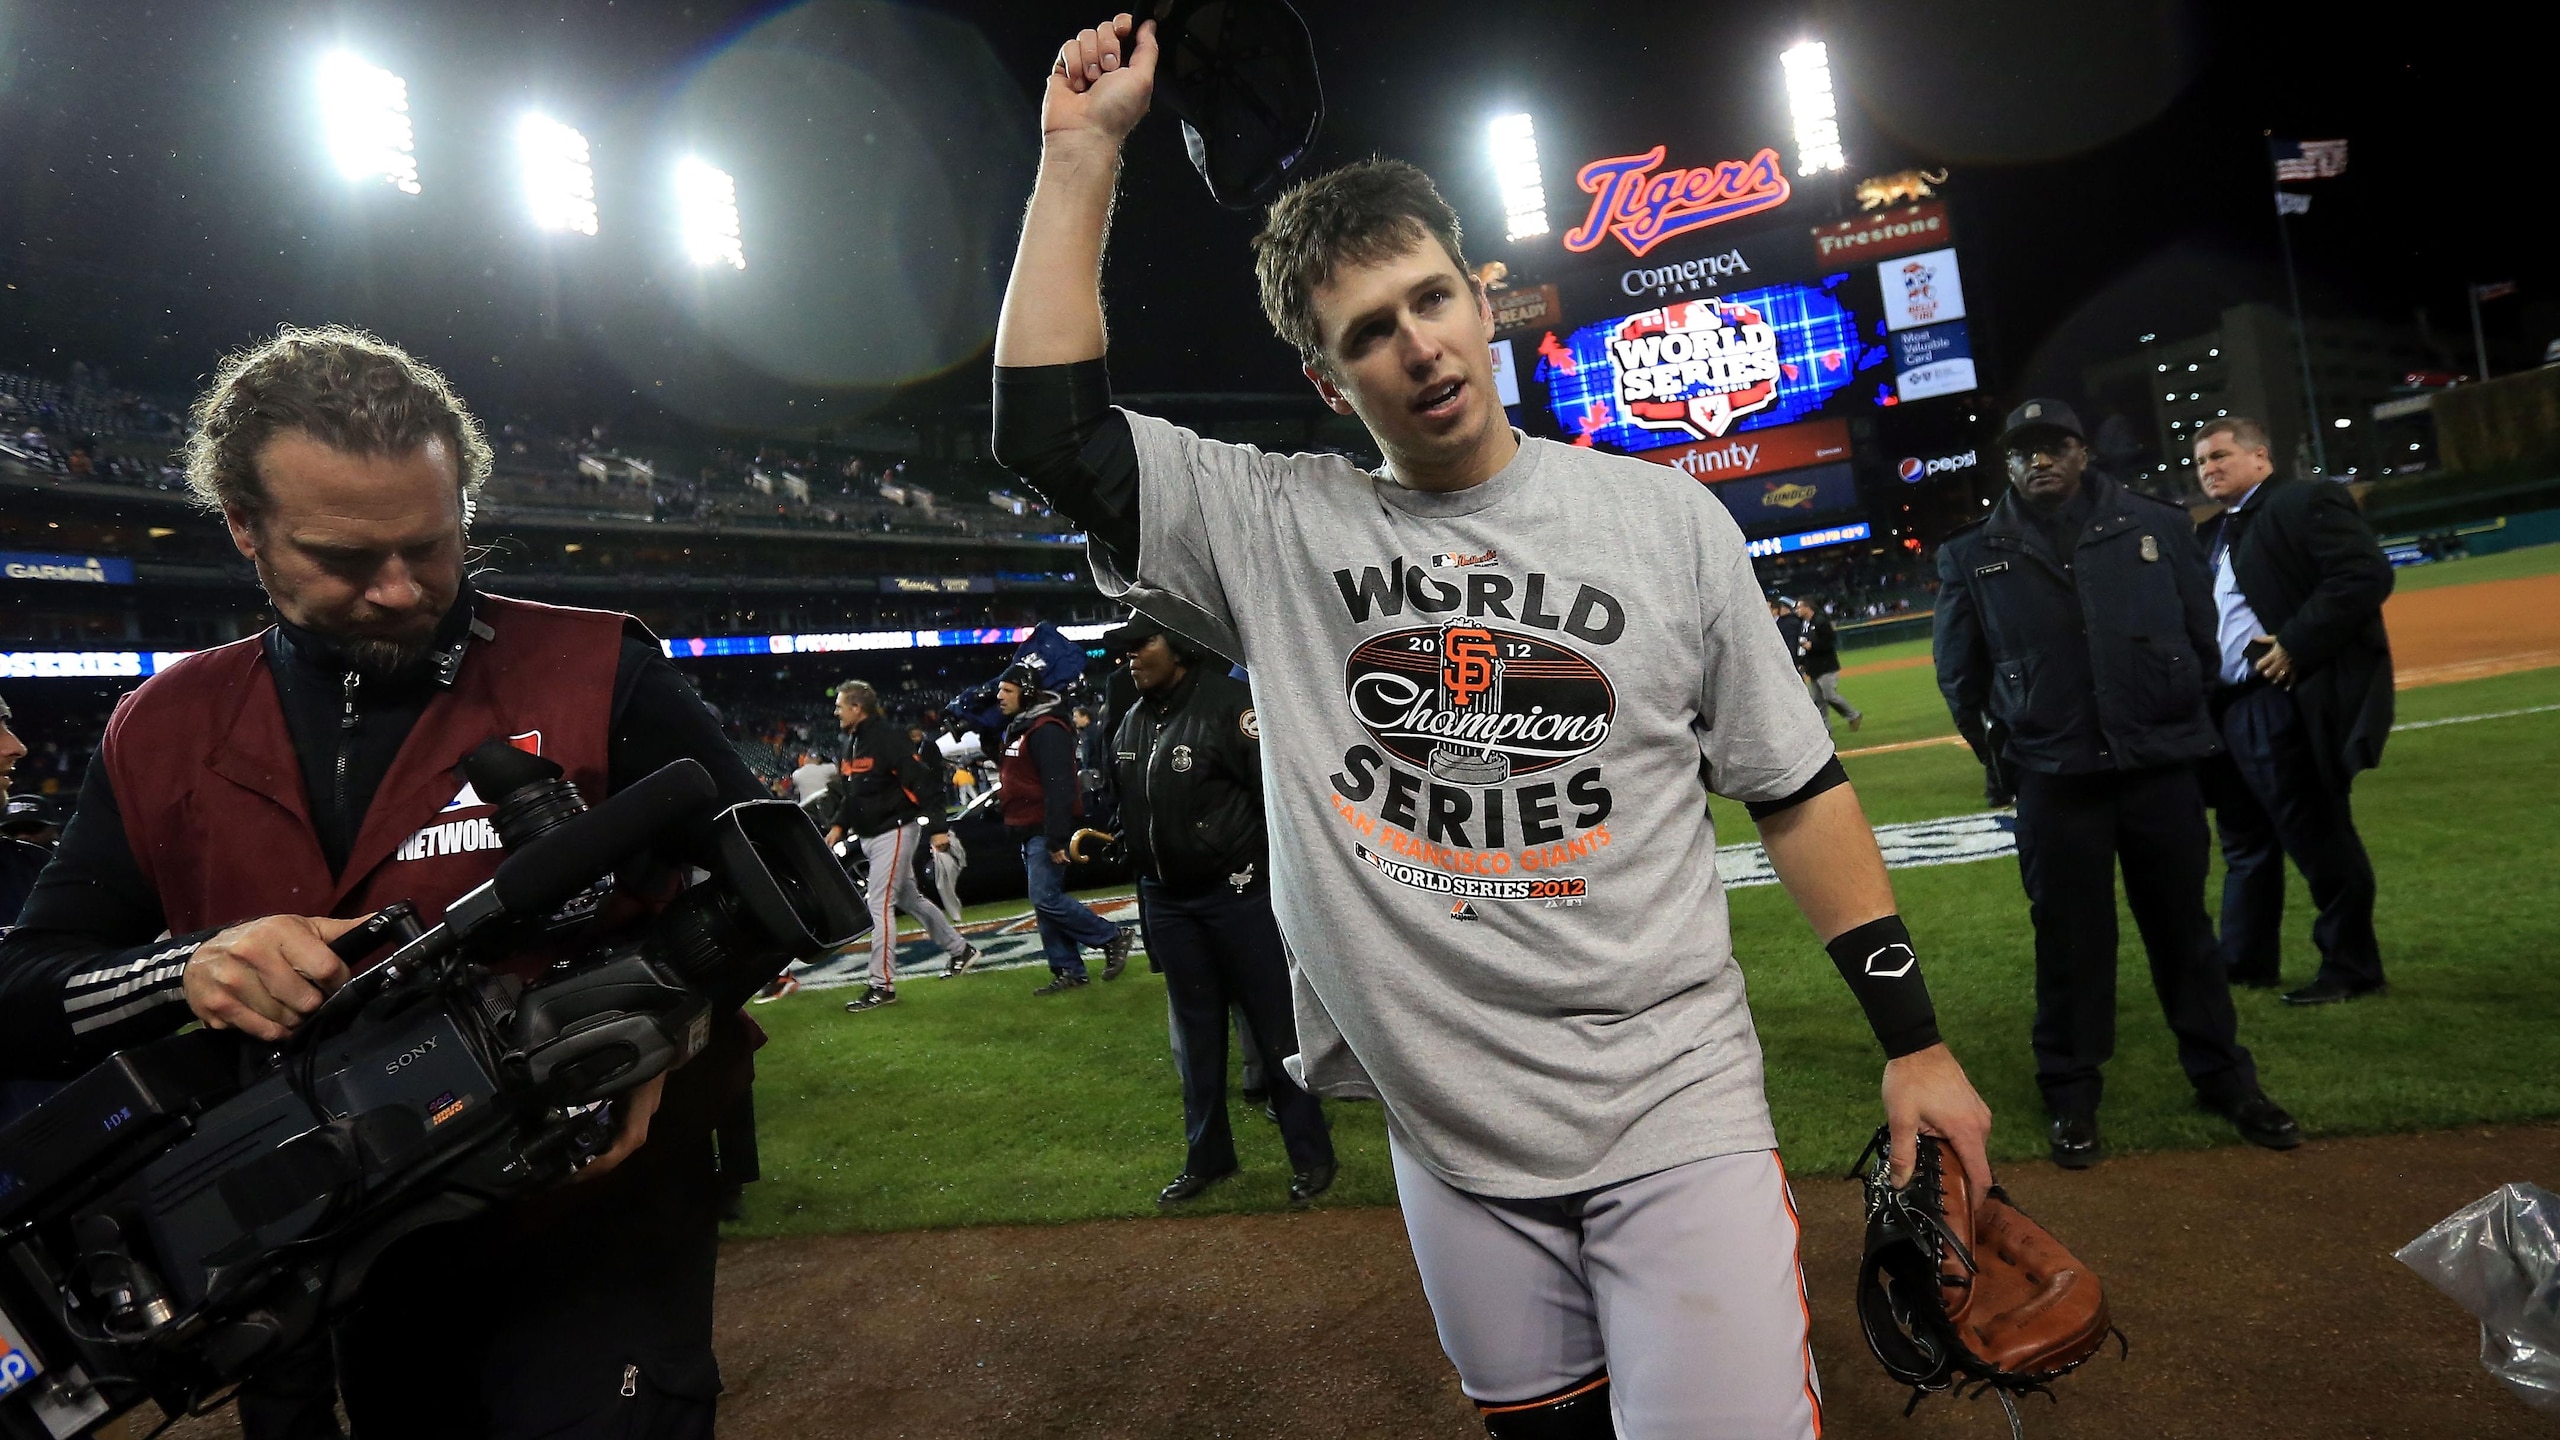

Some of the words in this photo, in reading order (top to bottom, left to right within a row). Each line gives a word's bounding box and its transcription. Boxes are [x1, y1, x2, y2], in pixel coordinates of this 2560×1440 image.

[1563, 145, 1790, 257] Tigers
[1819, 216, 1940, 255] Firestone
[1658, 276, 1718, 297] PARK
[1613, 323, 1775, 370] WORLD
[1902, 331, 1930, 343] Most
[1904, 338, 1950, 353] Valuable
[1622, 351, 1779, 401] SERIES
[1905, 350, 1933, 365] Card
[1670, 442, 1759, 474] xfinity
[1926, 449, 1977, 477] pepsi
[1764, 485, 1817, 503] SUNOCO
[5, 559, 105, 582] GARMIN
[1332, 555, 1626, 646] WORLD
[1408, 636, 1435, 653] 20
[1506, 641, 1532, 658] 12
[1350, 672, 1611, 763] Champions
[1330, 744, 1612, 849] SERIES
[396, 817, 503, 861] NETWOR
[1331, 793, 1377, 837] SAN
[1378, 825, 1512, 875] FRANCISCO
[1520, 825, 1611, 871] GIANTS
[385, 1035, 438, 1075] SONY
